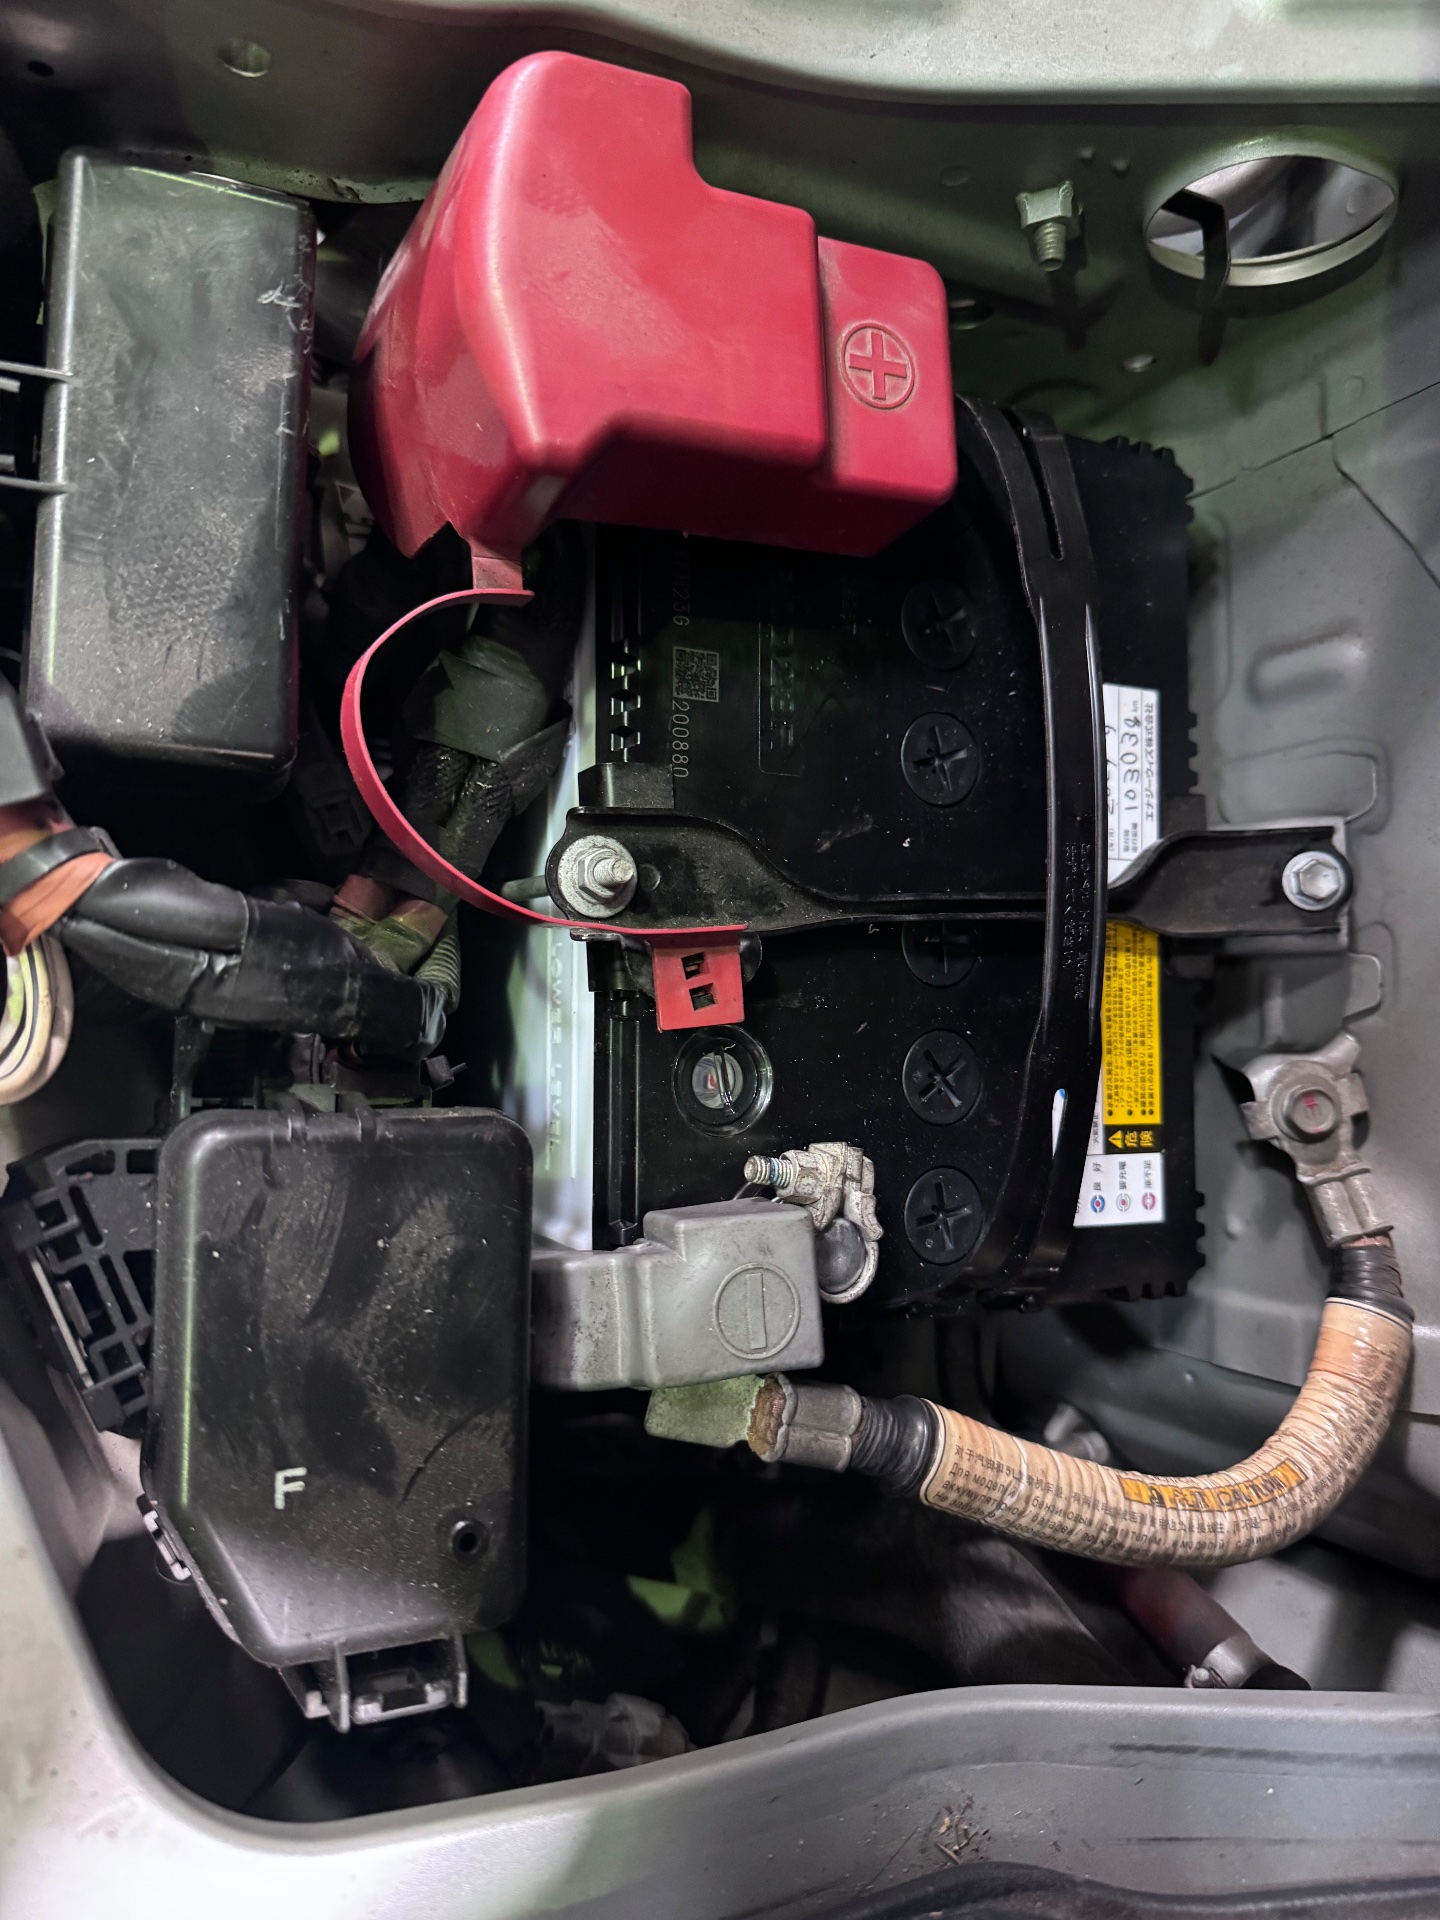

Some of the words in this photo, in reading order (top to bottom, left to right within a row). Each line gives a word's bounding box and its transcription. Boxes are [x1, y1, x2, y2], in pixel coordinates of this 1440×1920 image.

[671, 700, 690, 779] 200880
[551, 942, 563, 1044] LOWER
[1124, 1130, 1154, 1148] 危険
[274, 1466, 308, 1511] F
